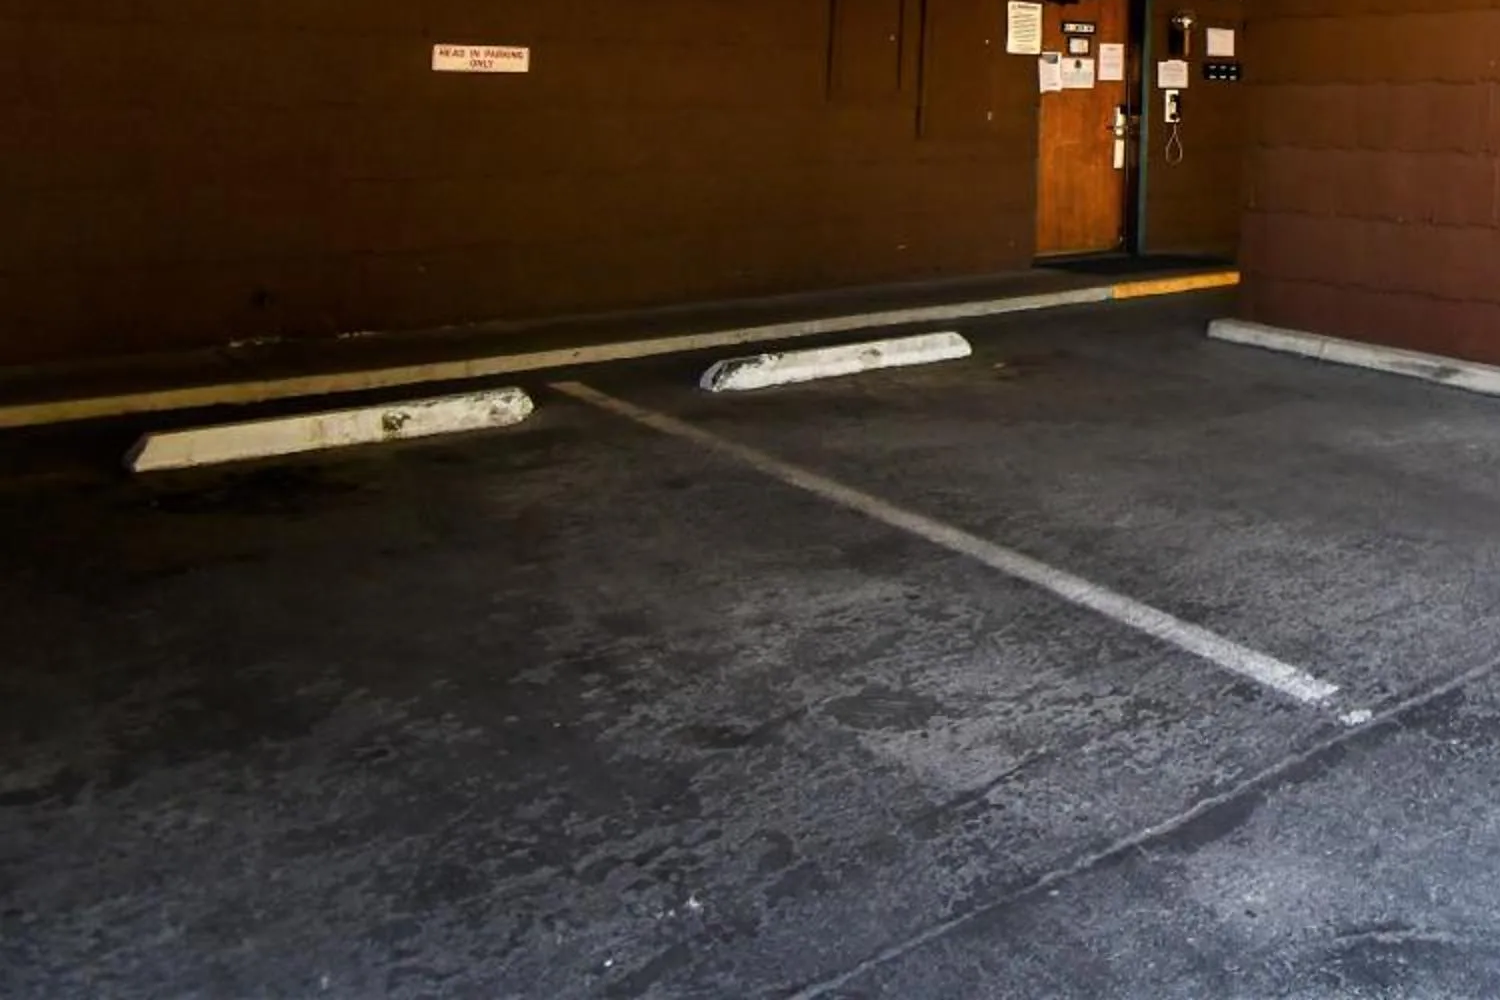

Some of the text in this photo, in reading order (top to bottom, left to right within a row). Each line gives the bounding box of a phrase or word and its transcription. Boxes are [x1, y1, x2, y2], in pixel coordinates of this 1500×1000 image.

[439, 48, 524, 59] HEAD IN PARKING
[469, 59, 494, 69] ONLY
